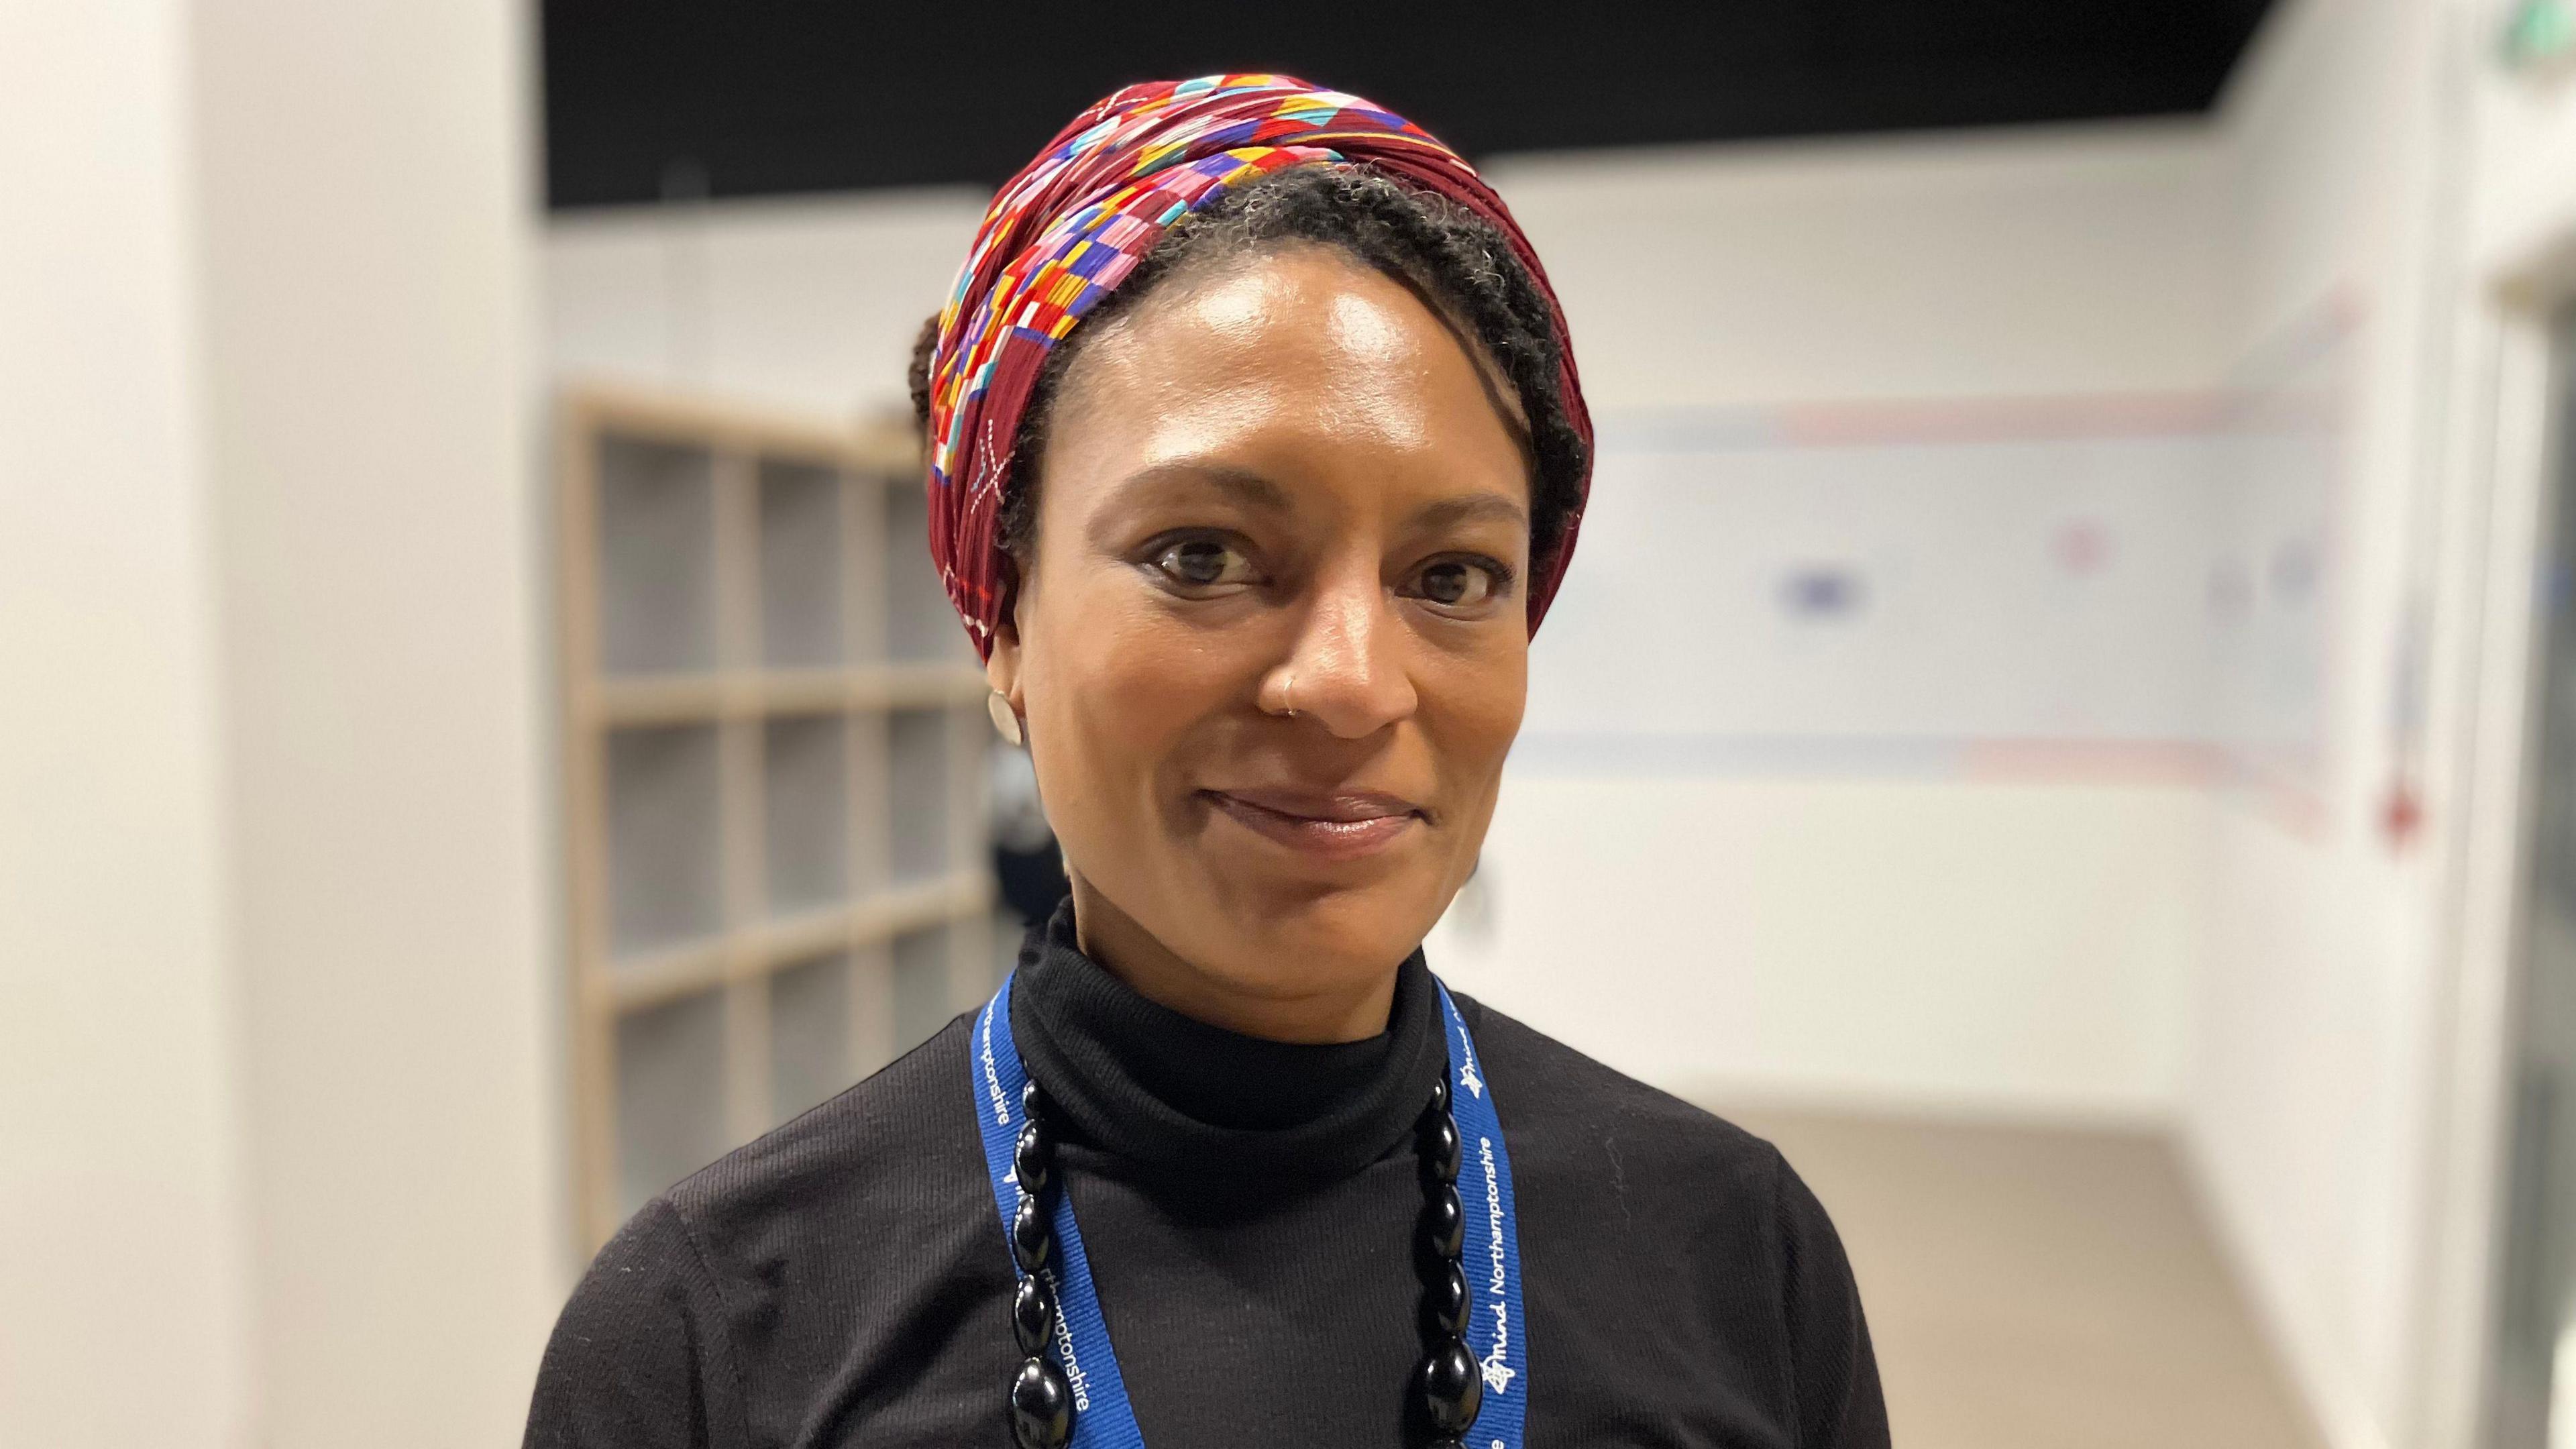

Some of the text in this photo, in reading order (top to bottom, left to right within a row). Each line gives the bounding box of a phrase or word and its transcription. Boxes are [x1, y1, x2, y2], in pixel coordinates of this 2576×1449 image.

[981, 989, 1010, 1125] rthamptonshire
[1479, 1136, 1507, 1360] mind Northamptonshire
[1040, 1267, 1090, 1412] rthmptonshire
